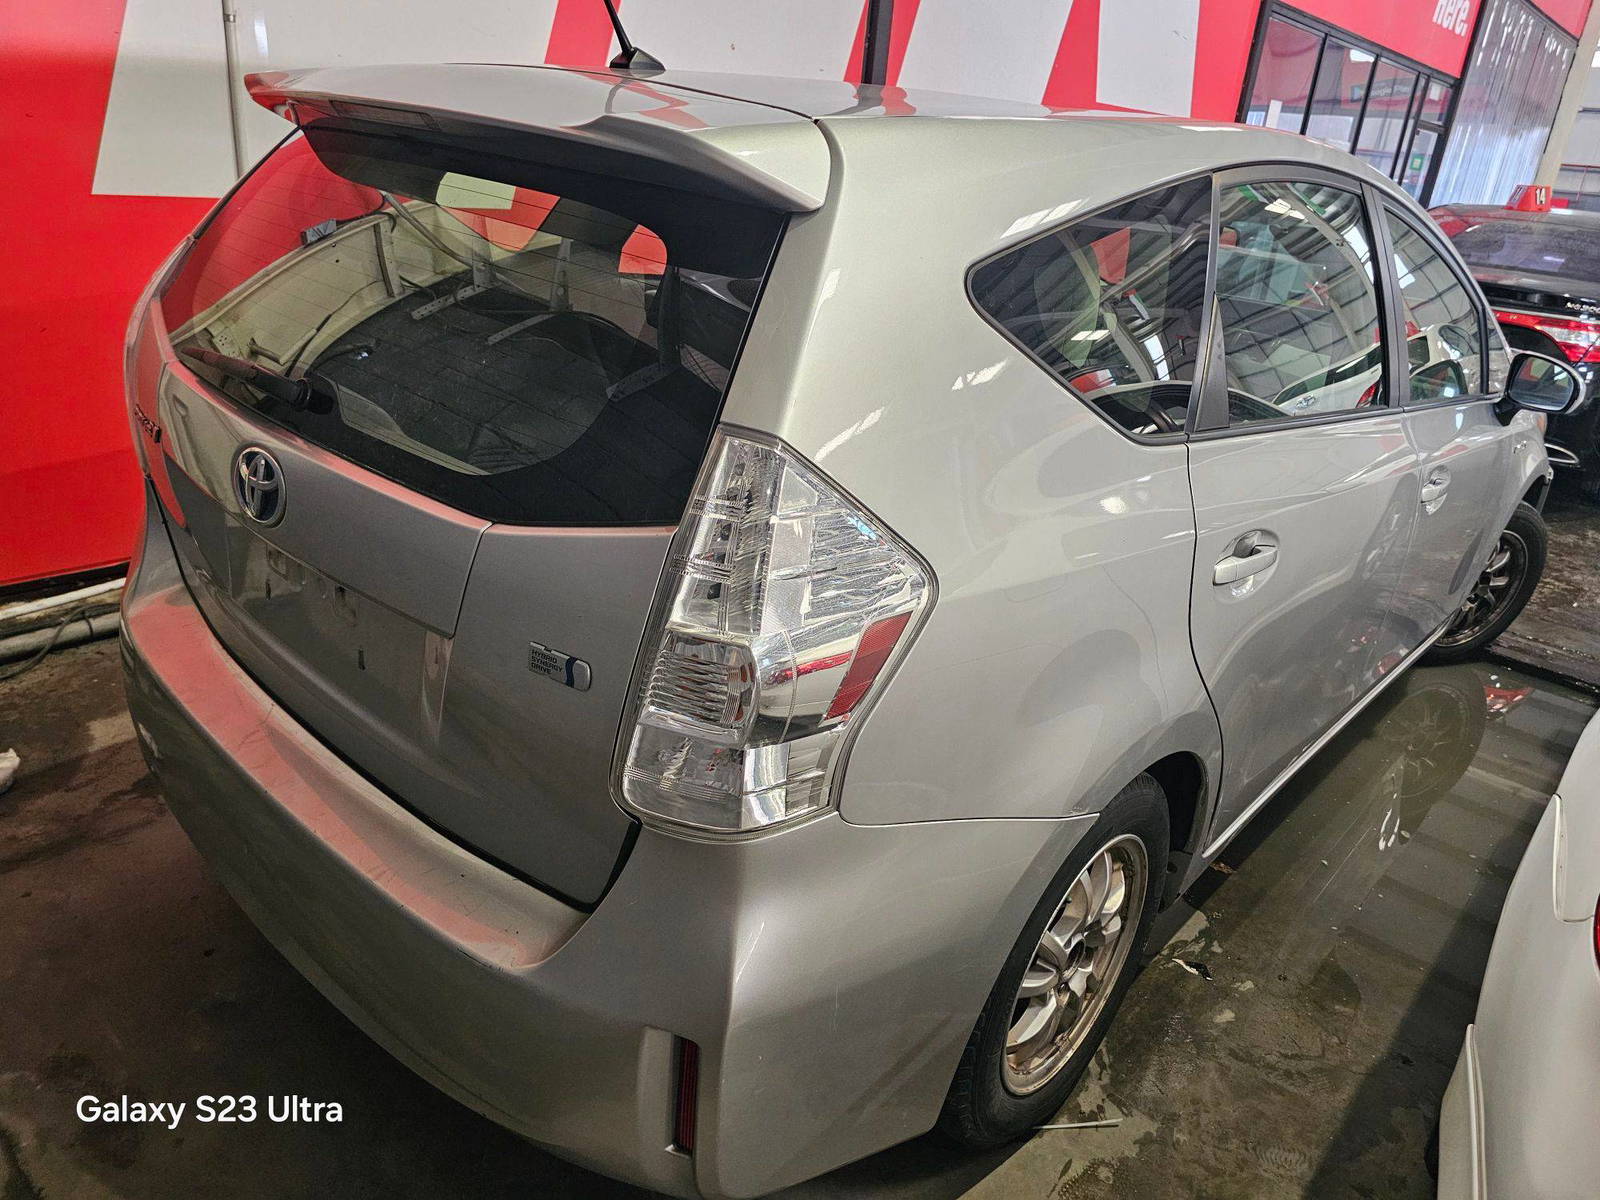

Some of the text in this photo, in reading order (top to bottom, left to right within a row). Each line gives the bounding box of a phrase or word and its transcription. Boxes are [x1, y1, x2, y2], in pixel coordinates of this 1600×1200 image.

[1535, 187, 1546, 206] 14
[531, 648, 558, 664] HYBRID
[531, 655, 563, 673] SYNERGY
[531, 662, 552, 675] DRIVE
